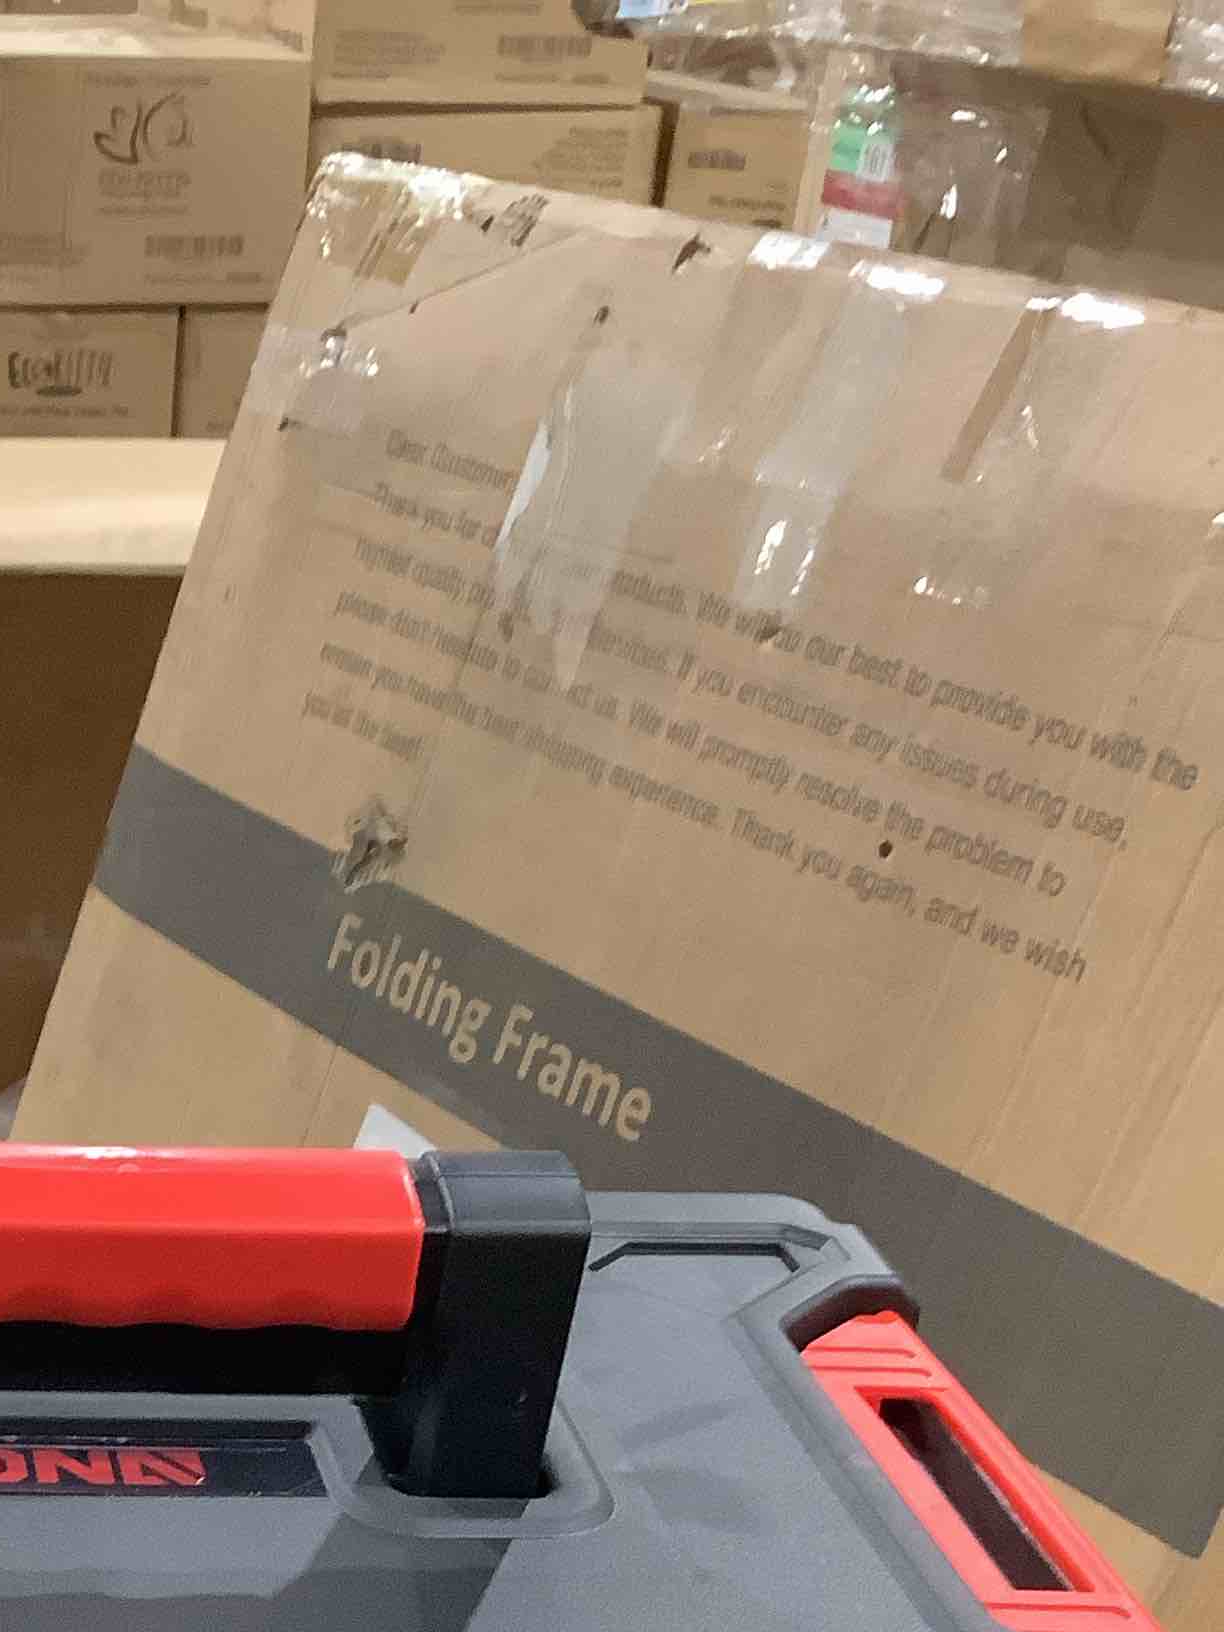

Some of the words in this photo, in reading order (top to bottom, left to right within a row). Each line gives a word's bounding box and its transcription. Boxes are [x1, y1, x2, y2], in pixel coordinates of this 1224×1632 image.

[677, 648, 695, 681] If
[690, 663, 733, 697] you
[736, 678, 849, 737] encounter
[849, 720, 896, 763] any
[898, 740, 980, 791] issues
[983, 766, 1074, 830] during
[1071, 802, 1129, 853] use,
[695, 590, 731, 628] We
[804, 634, 847, 669] our
[847, 642, 903, 689] best
[903, 666, 933, 699] to
[929, 679, 1032, 731] provide
[1028, 712, 1088, 753] you
[1089, 731, 1149, 775] with
[1149, 747, 1200, 792] the
[629, 697, 664, 738] We
[664, 718, 701, 751] will
[697, 734, 793, 794] promptly
[795, 770, 880, 825] resolve
[880, 799, 925, 842] the
[924, 821, 1034, 887] problem
[1035, 861, 1067, 898] to
[731, 806, 795, 859] Thank
[793, 845, 841, 881] you
[845, 862, 916, 920] again,
[923, 896, 980, 940] and
[980, 917, 1021, 956] we
[1022, 932, 1089, 984] wish
[327, 912, 493, 1064] Folding
[492, 1003, 652, 1142] Frame
